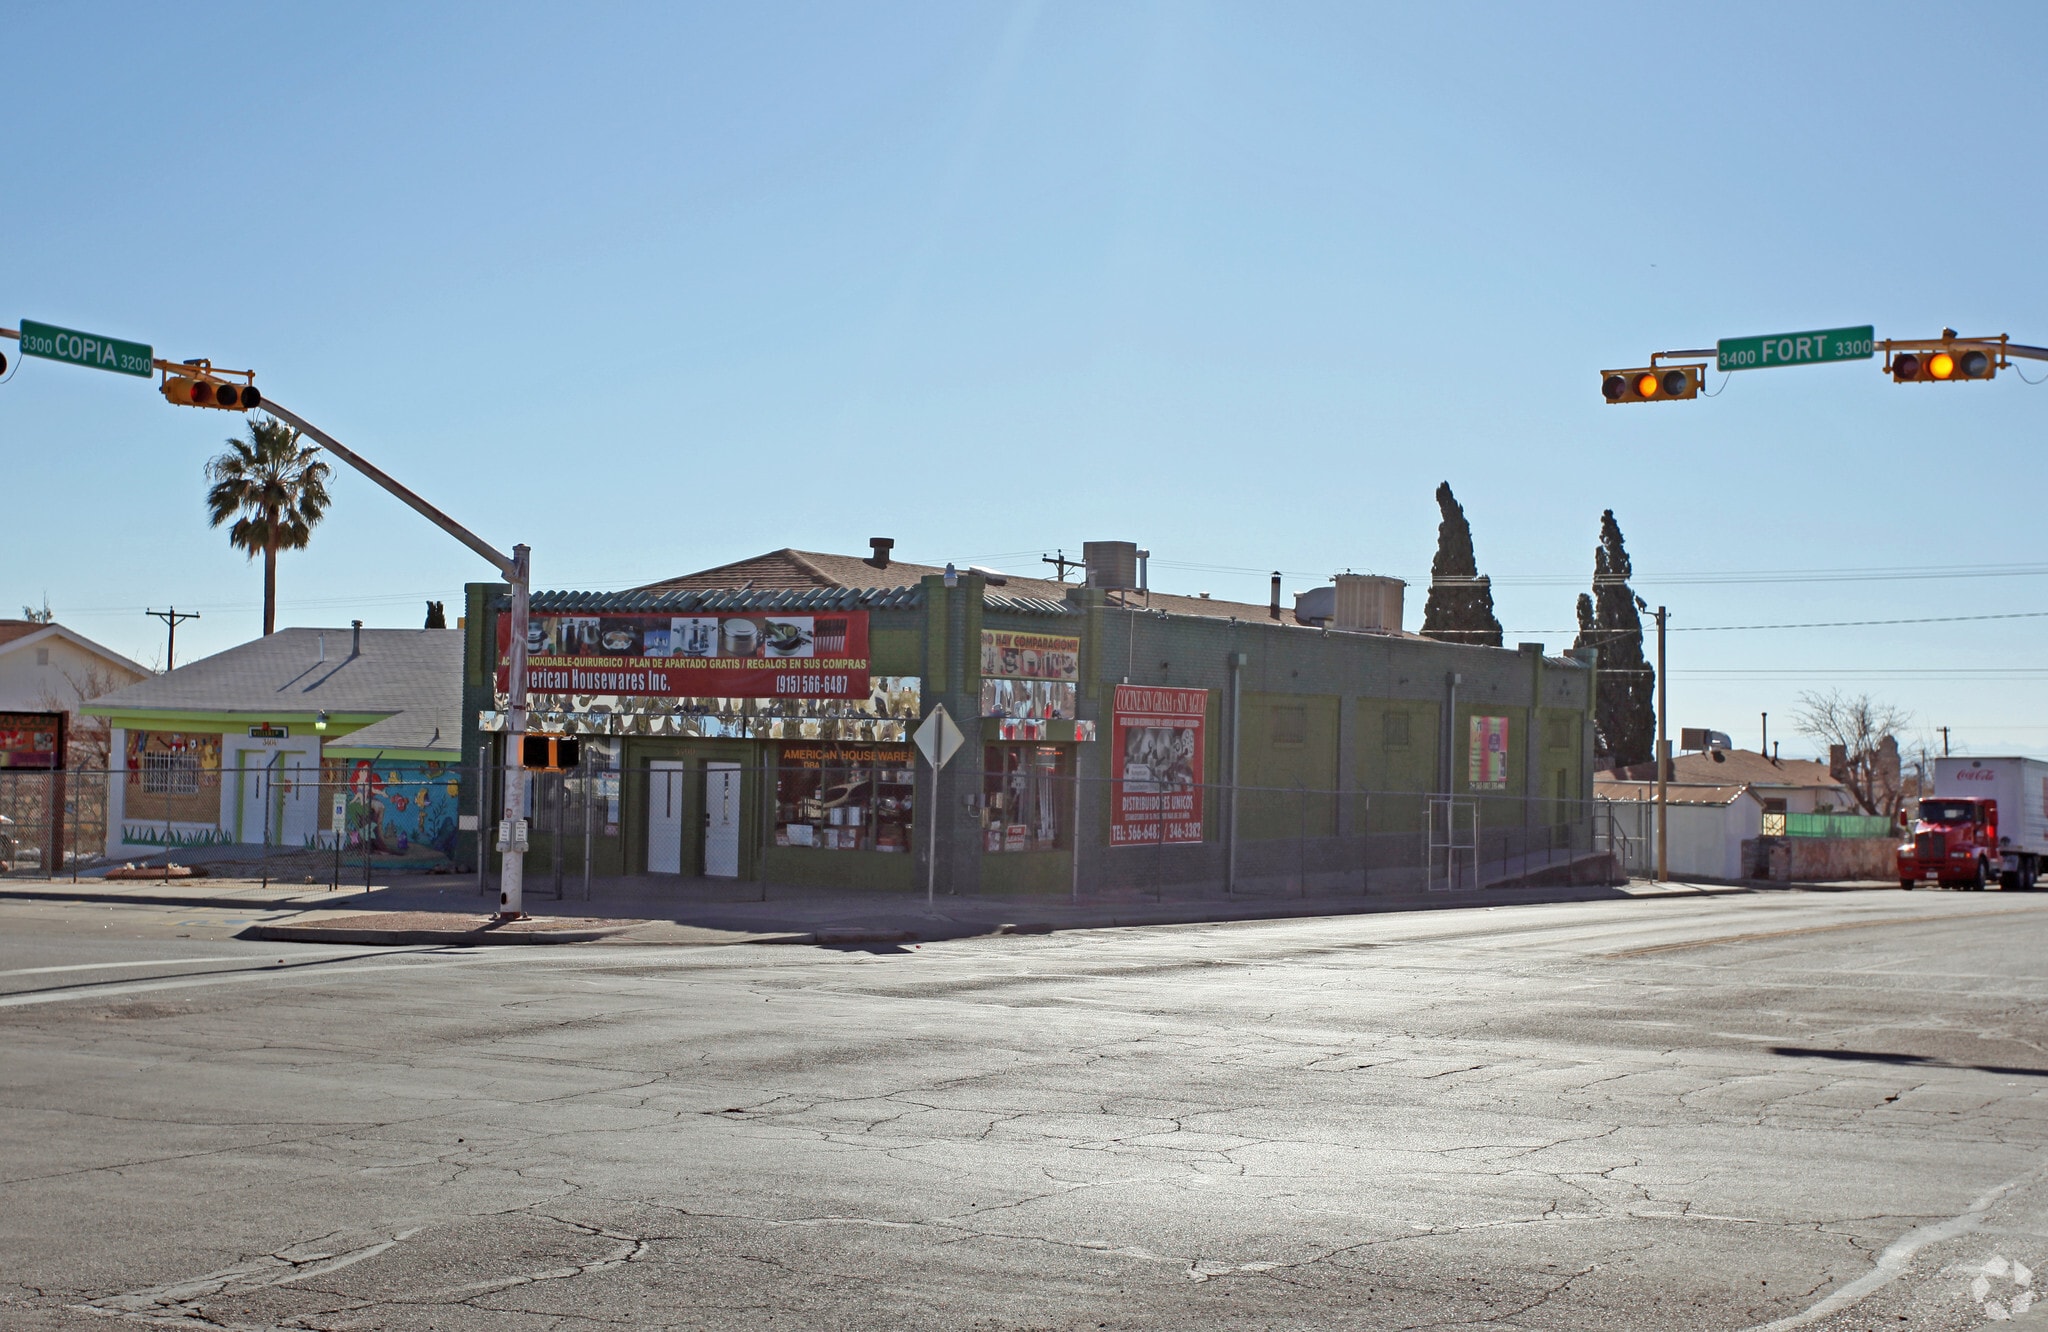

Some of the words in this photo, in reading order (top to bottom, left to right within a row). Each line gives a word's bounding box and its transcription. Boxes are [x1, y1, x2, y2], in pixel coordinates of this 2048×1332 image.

[22, 335, 52, 354] 3300
[55, 333, 117, 367] COPIA
[121, 354, 151, 373] 3200
[1720, 350, 1756, 366] 3400
[1762, 335, 1827, 363] FORT
[1835, 339, 1871, 357] 3300
[996, 633, 1013, 646] HAY
[527, 656, 623, 668] INOXIDABLE-QUIRURGICO
[629, 658, 650, 668] PLAN
[652, 658, 663, 668] DE
[665, 658, 707, 669] APARTADO
[709, 658, 740, 669] GRATIS
[747, 658, 787, 669] REGALOS
[789, 659, 801, 669] EN
[803, 658, 820, 669] SUS
[822, 658, 867, 669] COMPRAS
[527, 668, 569, 689] erican
[571, 669, 645, 691] Housewares
[648, 670, 671, 691] Inc.
[776, 675, 800, 693] (915)
[802, 675, 848, 694] 566-6487
[784, 749, 838, 760] AMERICAN
[1112, 825, 1126, 841] TEL:
